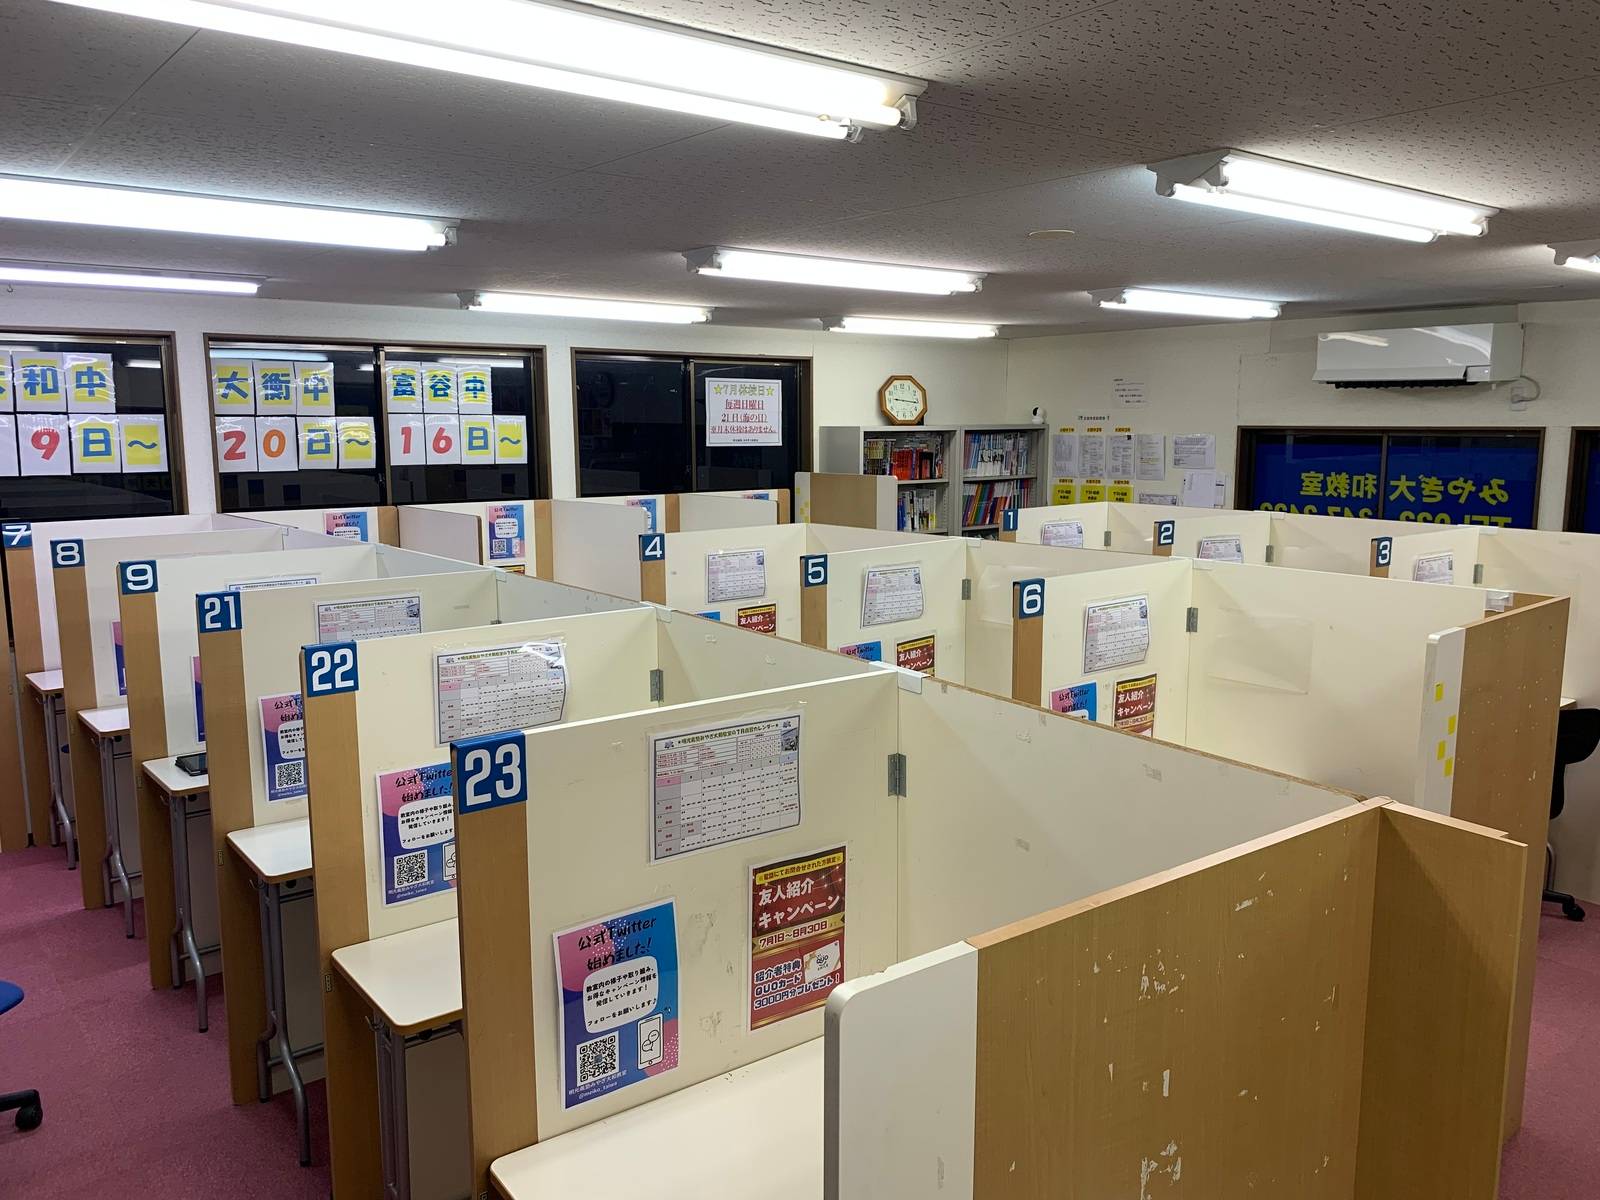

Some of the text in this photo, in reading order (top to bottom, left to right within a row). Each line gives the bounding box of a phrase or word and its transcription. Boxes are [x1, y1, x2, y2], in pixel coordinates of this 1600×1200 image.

[0, 364, 107, 397] 和中
[393, 372, 485, 398] 富谷中
[1007, 511, 1014, 529] 1
[1160, 523, 1173, 544] 2
[5, 525, 30, 546] 7
[644, 536, 663, 558] 4
[56, 542, 80, 566] 8
[1379, 540, 1390, 564] 3
[126, 564, 154, 591] 9
[807, 557, 825, 584] 5
[204, 594, 237, 629] 21
[1022, 583, 1042, 614] 6
[311, 648, 354, 692] 22
[1117, 701, 1153, 716] キャンペーン
[395, 768, 452, 788] 公式Twitte
[465, 743, 521, 806] 23
[758, 877, 814, 906] 友人紹介
[758, 895, 840, 929] キャンペーン
[578, 917, 657, 951] 公式Twitter
[587, 938, 653, 971] 始めました!
[755, 958, 801, 984] 紹介者特典
[755, 972, 802, 997] QUOカード
[586, 972, 657, 1002] お得なキャンペーン情報を
